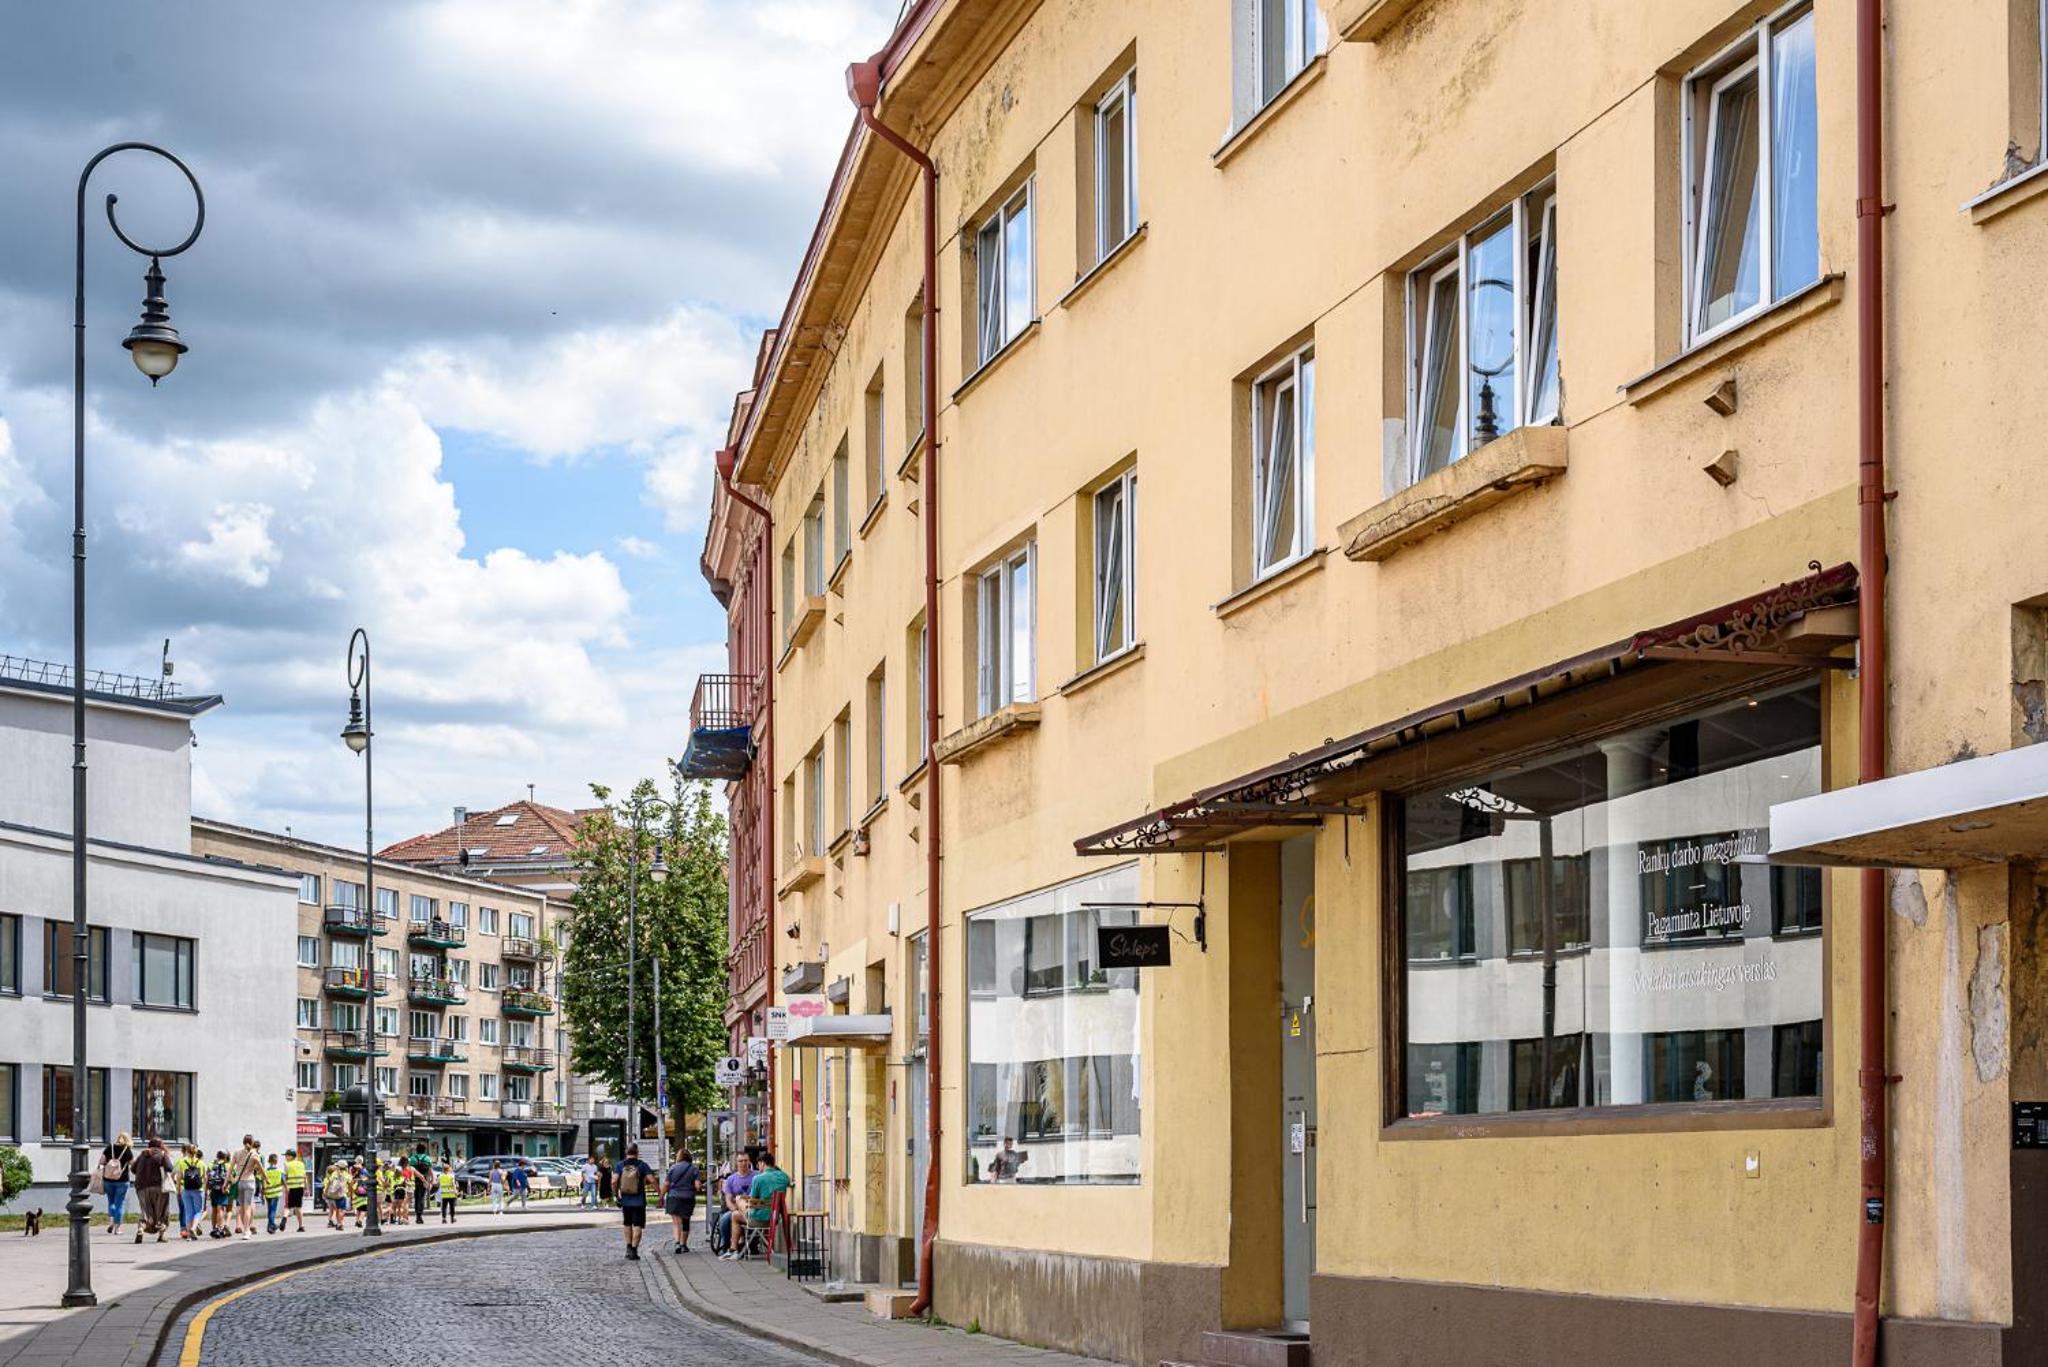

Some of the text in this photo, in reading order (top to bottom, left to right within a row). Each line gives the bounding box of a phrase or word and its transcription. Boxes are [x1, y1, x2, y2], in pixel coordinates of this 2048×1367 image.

[1639, 846, 1669, 875] Rankų
[1671, 840, 1700, 868] darbo
[1648, 899, 1751, 941] Pagaminta Lietuvoje
[1737, 954, 1777, 984] verslas
